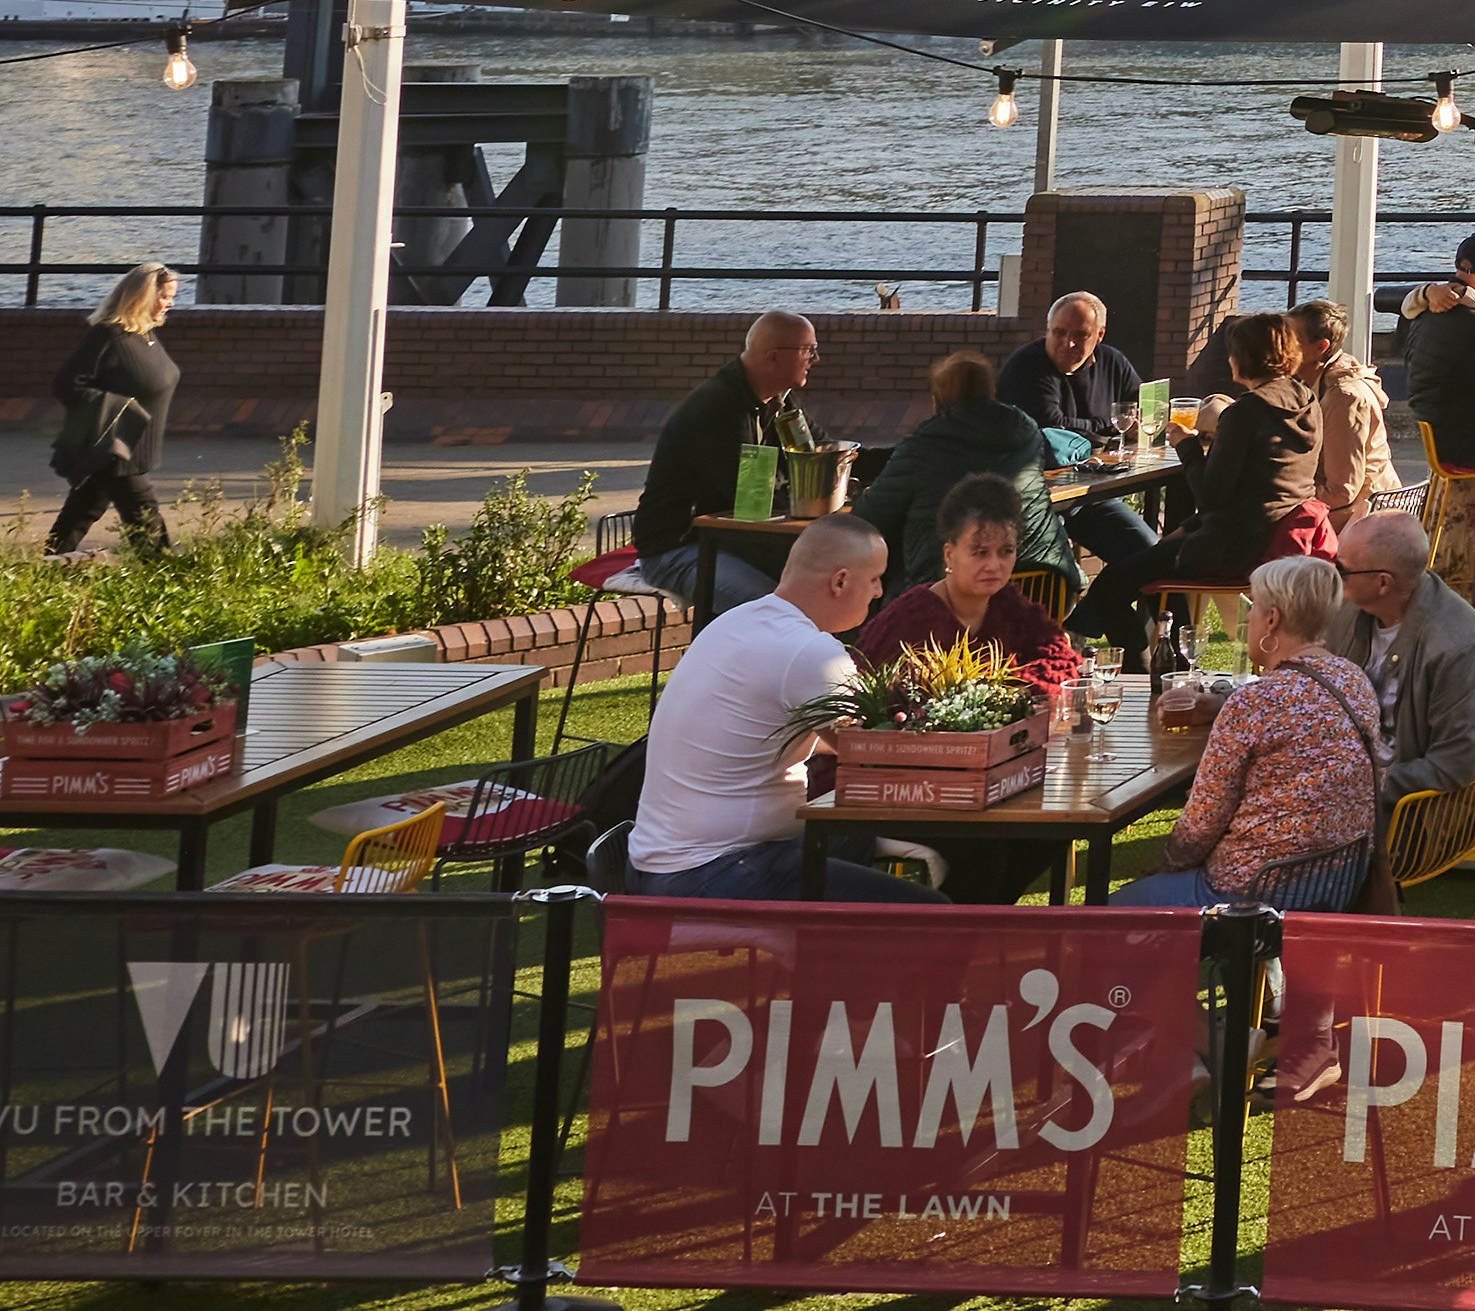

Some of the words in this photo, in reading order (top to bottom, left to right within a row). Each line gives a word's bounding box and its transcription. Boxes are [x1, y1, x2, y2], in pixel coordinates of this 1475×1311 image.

[17, 735, 36, 746] TIME
[38, 735, 55, 746] FOR
[58, 735, 65, 746] A
[851, 742, 866, 752] TIME
[868, 742, 885, 753] FOR
[887, 743, 894, 753] A
[895, 743, 944, 755] SUNDOWNER
[946, 745, 978, 756] SPRITZ?
[52, 772, 110, 795] PIMM'S
[882, 780, 936, 803] PIMM'S
[54, 1105, 166, 1137] FROM
[181, 1105, 255, 1137] THE
[271, 1106, 412, 1138] TOWER
[56, 1181, 124, 1208] BAR
[136, 1182, 158, 1208] &
[172, 1181, 328, 1209] KITCHEN
[755, 1191, 798, 1218] AT
[811, 1192, 883, 1220] THE
[899, 1193, 1012, 1222] LAWN
[2, 1225, 64, 1239] LOCATED
[1428, 1214, 1474, 1243] AT
